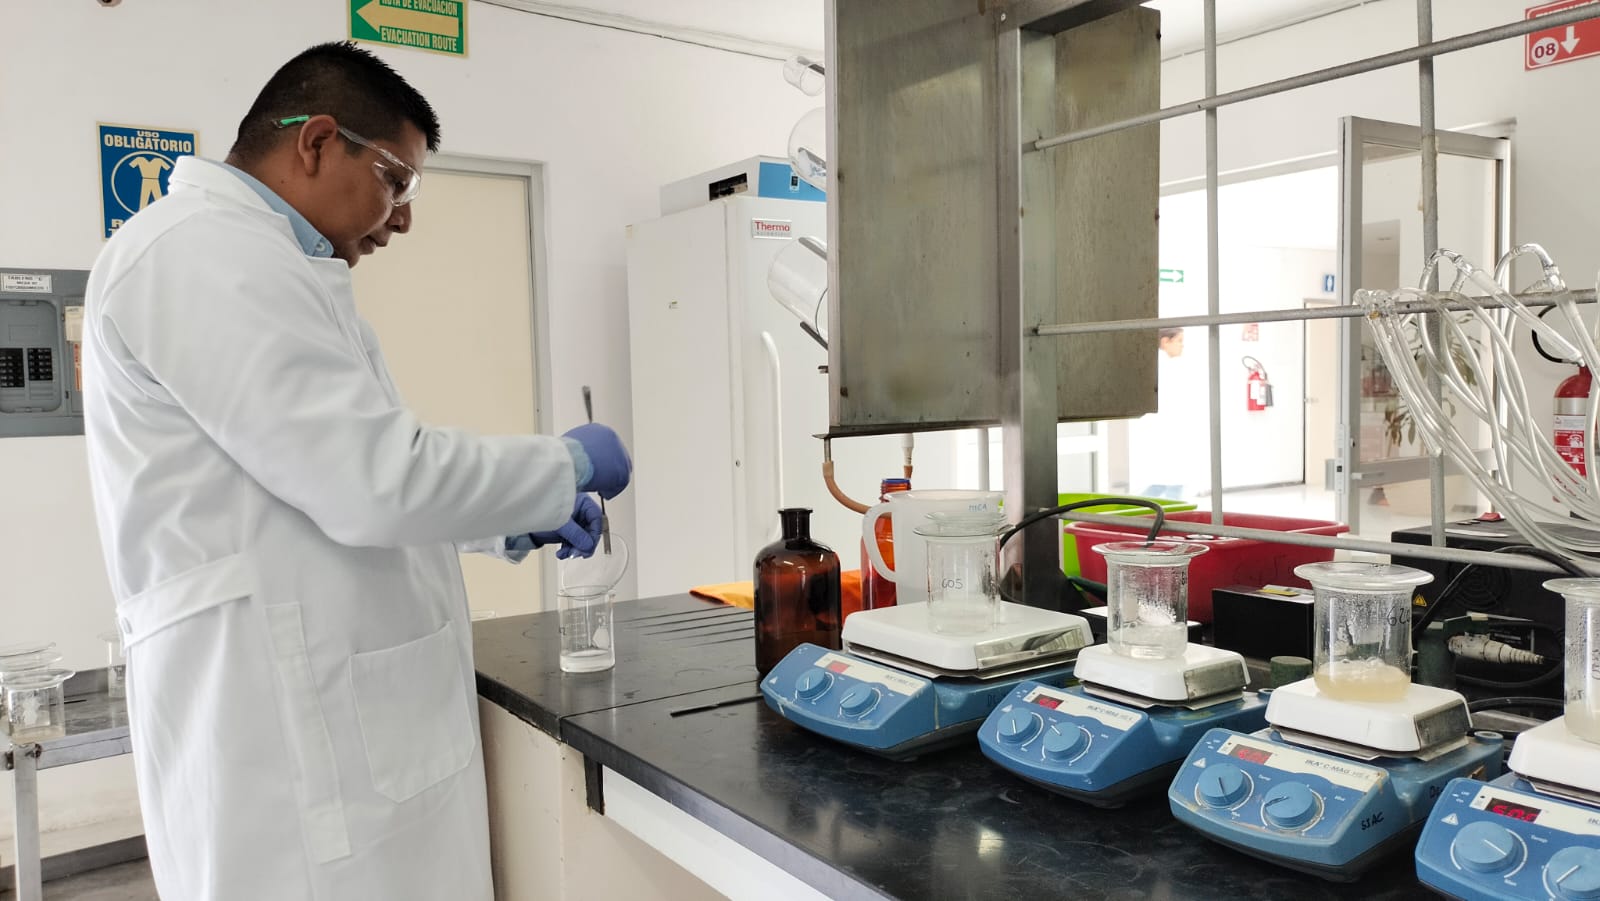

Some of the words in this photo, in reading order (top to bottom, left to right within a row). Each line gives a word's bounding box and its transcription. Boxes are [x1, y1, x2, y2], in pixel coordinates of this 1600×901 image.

[381, 27, 430, 48] EVACUATION
[432, 35, 457, 52] ROUTE
[1534, 42, 1556, 59] 08
[136, 130, 160, 138] USO
[104, 134, 192, 153] OBLIGATORIO
[754, 220, 790, 231] Thermo
